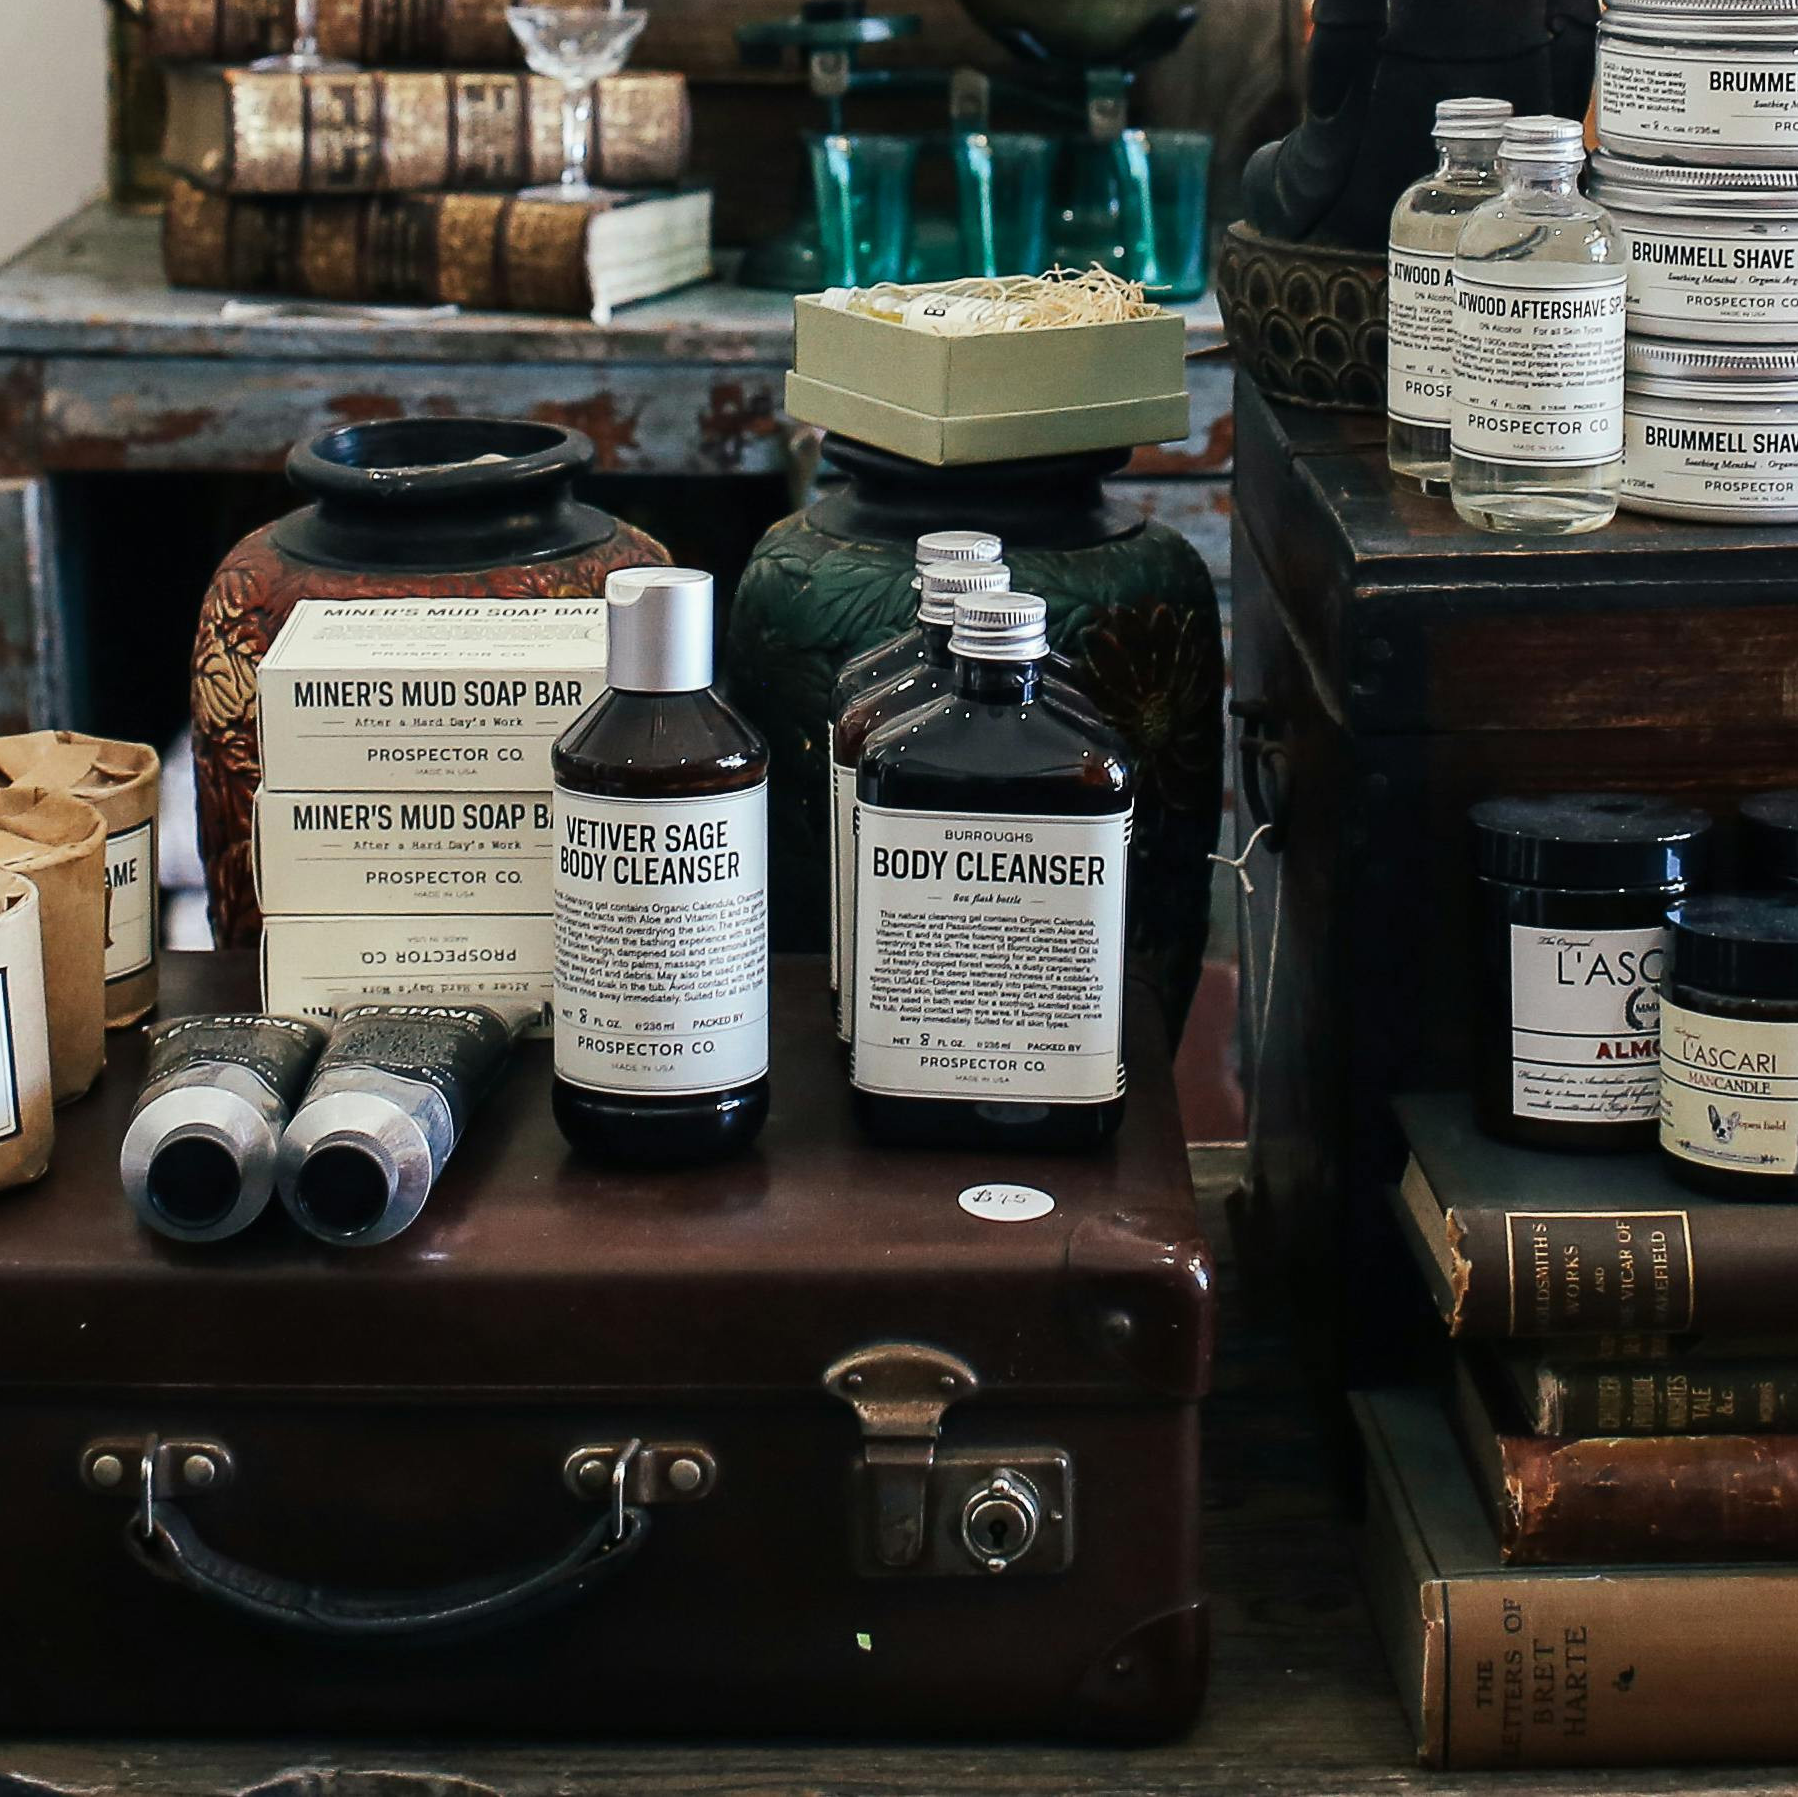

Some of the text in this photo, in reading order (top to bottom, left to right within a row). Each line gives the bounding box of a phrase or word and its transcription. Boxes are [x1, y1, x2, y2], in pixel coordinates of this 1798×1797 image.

[1632, 241, 1728, 268] BRUMMELL
[1733, 248, 1794, 269] SHAVE
[1395, 263, 1440, 286] ATWOOD
[1458, 291, 1506, 316] ATWOOD
[1511, 298, 1606, 319] AFTERSHAVE
[1687, 295, 1775, 308] PROSPECTOR
[1468, 414, 1582, 435] PROSPECTOR
[1645, 425, 1747, 453] BRUMMELL
[1705, 480, 1793, 492] PROSPECTOR
[324, 607, 600, 617] MINER'S MUD SOAP BAR
[294, 680, 582, 708] MINER'S MUD SOAP BAR
[355, 717, 523, 728] After Hard Day's Work
[367, 748, 488, 762] PROSPECTOR
[293, 804, 392, 831] MINER'S
[402, 804, 454, 830] MUD
[463, 804, 526, 830] SOAP
[566, 815, 656, 852] VETIVER
[665, 820, 729, 851] SAGE
[945, 829, 1034, 843] BURROUGHS
[106, 858, 138, 888] AME
[365, 870, 522, 885] PROSPECTOR CO.
[560, 846, 740, 885] BODY CLEANSER
[873, 846, 1105, 886] BODY CLEANSER
[611, 903, 689, 914] contains Organic
[626, 925, 675, 938] overdrying
[396, 949, 517, 962] PROSPECTOR
[1557, 948, 1664, 987] L'ASC
[693, 1015, 732, 1029] PACKED
[578, 1036, 716, 1056] PROSPECTOR CO.
[1682, 1040, 1777, 1073] L'ASCARI
[920, 1056, 1017, 1071] PROSPECTOR
[1688, 1073, 1772, 1096] MANCANDLE
[1616, 1220, 1635, 1300] VICAR OF
[1652, 1229, 1668, 1313] AKEFIELD
[1503, 1598, 1522, 1633] OF
[1477, 1659, 1493, 1709] THE
[1533, 1638, 1554, 1725] BRET
[1564, 1626, 1588, 1737] HARTE
